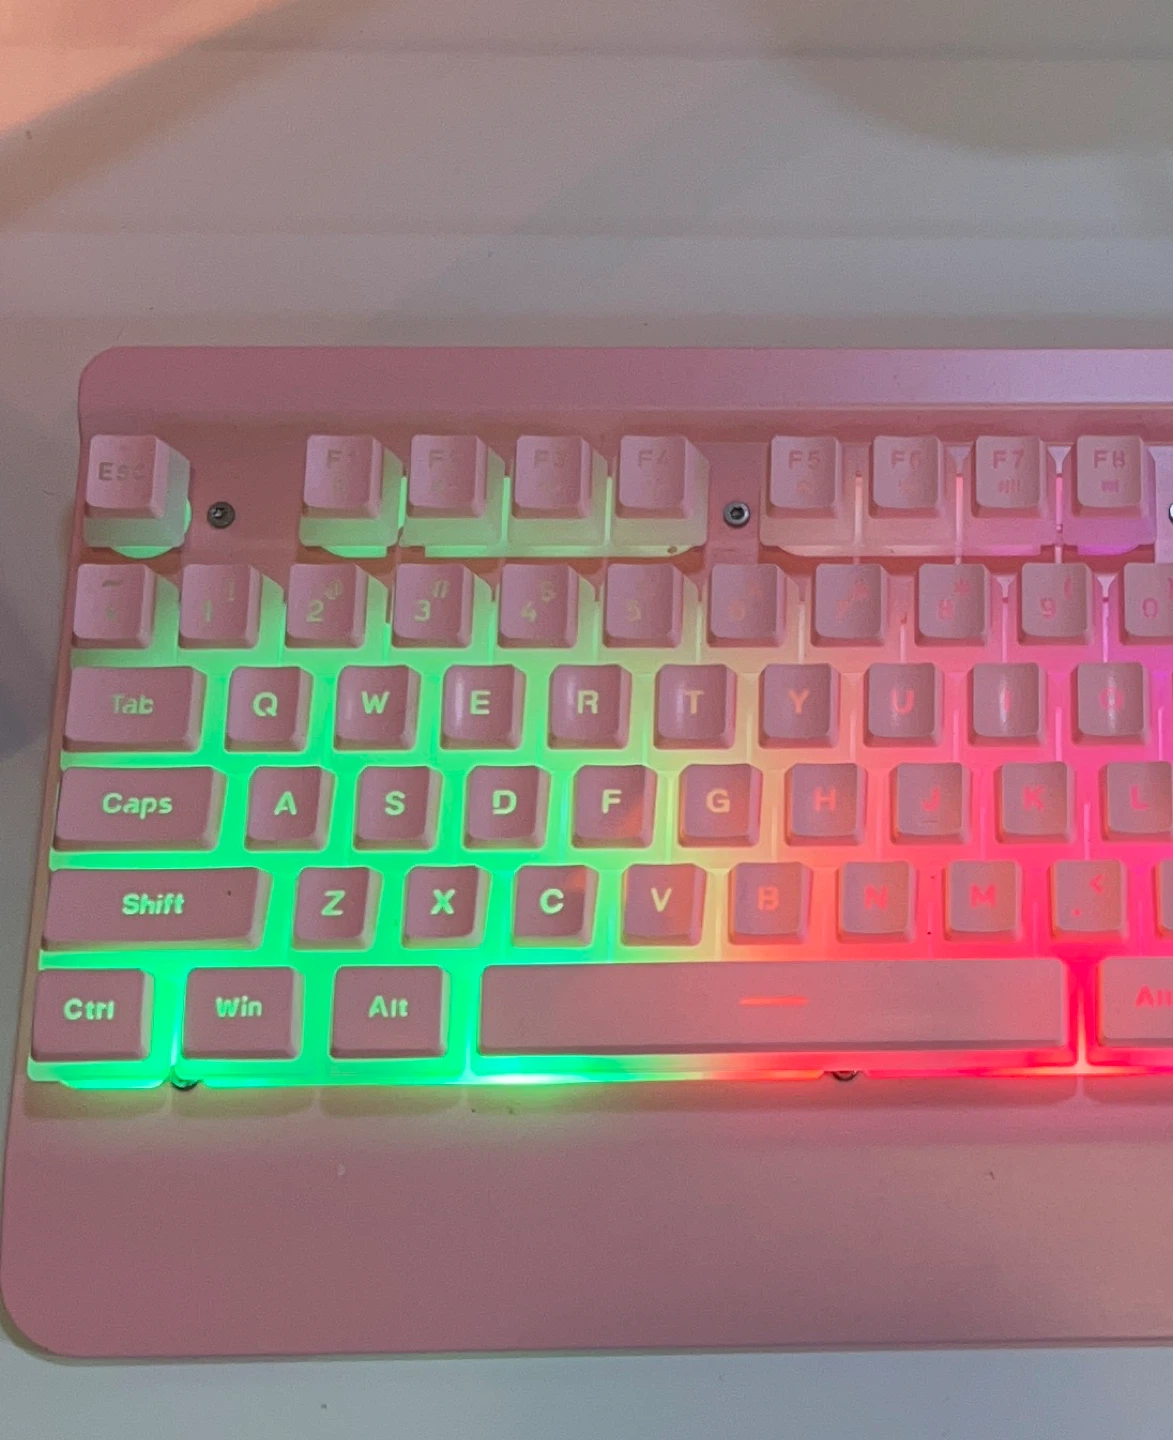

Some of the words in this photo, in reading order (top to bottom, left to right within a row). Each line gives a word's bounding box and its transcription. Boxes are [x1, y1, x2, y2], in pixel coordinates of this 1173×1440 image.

[787, 450, 821, 470] F5
[991, 449, 1025, 469] F7
[305, 599, 324, 623] 2
[413, 599, 432, 623] 3
[520, 600, 537, 622] 4
[110, 693, 154, 716] Tab
[251, 692, 279, 718] Q
[360, 690, 391, 714] W
[469, 690, 491, 716] E
[576, 690, 600, 715] R
[681, 689, 705, 714] T
[787, 688, 811, 714] Y
[890, 688, 916, 715] U
[102, 791, 174, 819] Caps
[273, 791, 298, 816] A
[383, 790, 406, 816] S
[492, 789, 517, 815] D
[601, 789, 622, 814] F
[705, 788, 732, 815] G
[813, 788, 837, 813] H
[920, 788, 941, 813] J
[1022, 786, 1045, 811] K
[1129, 785, 1149, 810] L
[121, 891, 186, 917] Shift
[321, 890, 345, 917] Z
[430, 889, 455, 915] X
[539, 888, 564, 915] C
[649, 886, 673, 913] V
[757, 885, 780, 911] B
[863, 884, 889, 910] N
[968, 883, 997, 909] M
[63, 998, 116, 1022] Ctrl
[215, 996, 263, 1019] Win
[368, 995, 409, 1019] Alt
